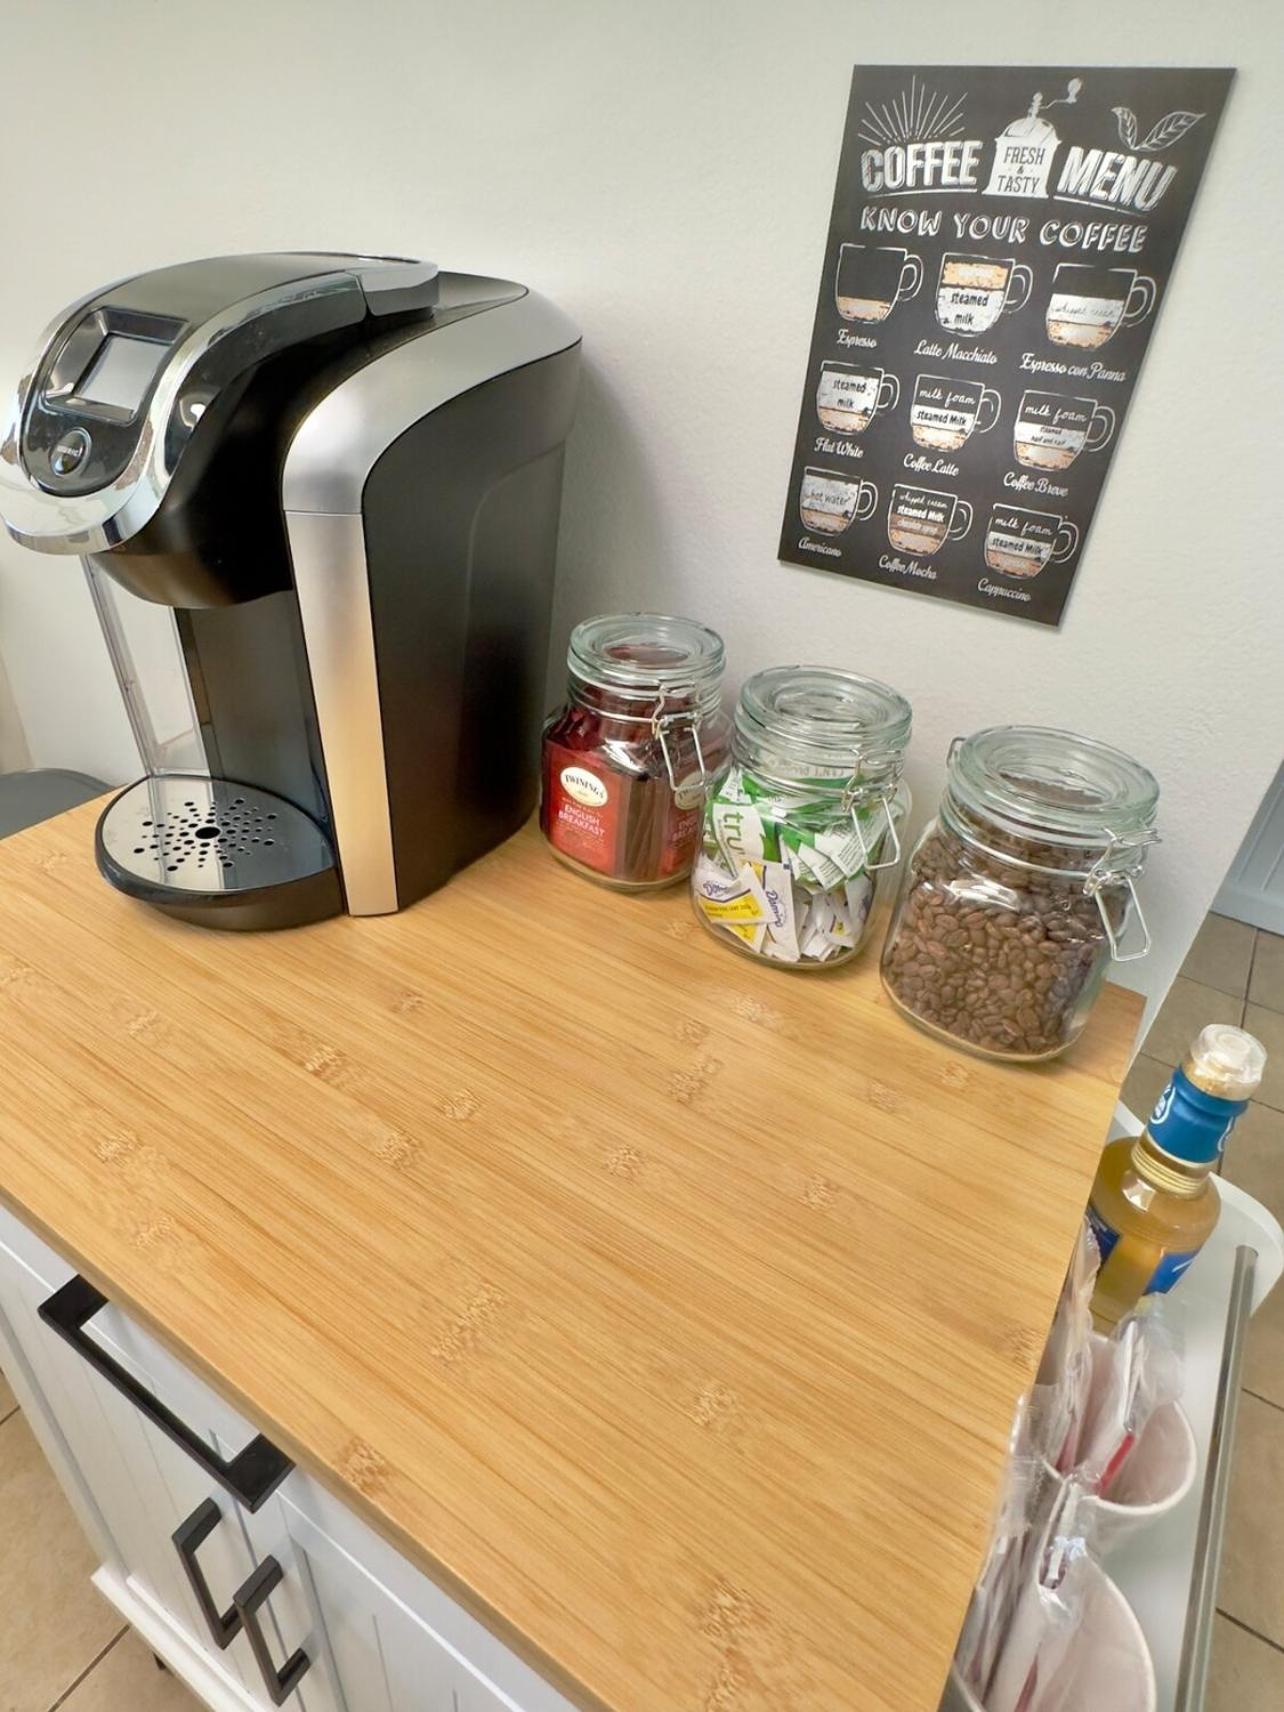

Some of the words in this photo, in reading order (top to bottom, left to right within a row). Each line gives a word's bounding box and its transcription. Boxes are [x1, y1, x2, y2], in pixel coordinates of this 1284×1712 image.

[1003, 146, 1046, 165] FRESH
[860, 139, 984, 193] COFFEE
[1056, 145, 1179, 212] MENU
[997, 175, 1041, 193] TASTY
[860, 205, 943, 237] KNOW
[953, 214, 1031, 244] YOUR
[1038, 219, 1149, 253] COFFEE
[914, 339, 942, 357] Latte
[1019, 352, 1067, 374] Espresso
[903, 453, 932, 473] Coffee
[931, 458, 960, 477] Latte
[1003, 471, 1035, 491] Coffee
[879, 554, 906, 574] Coffee
[558, 809, 606, 837] BREAKFAST
[564, 803, 600, 826] ENGLISH
[723, 811, 746, 855] tru
